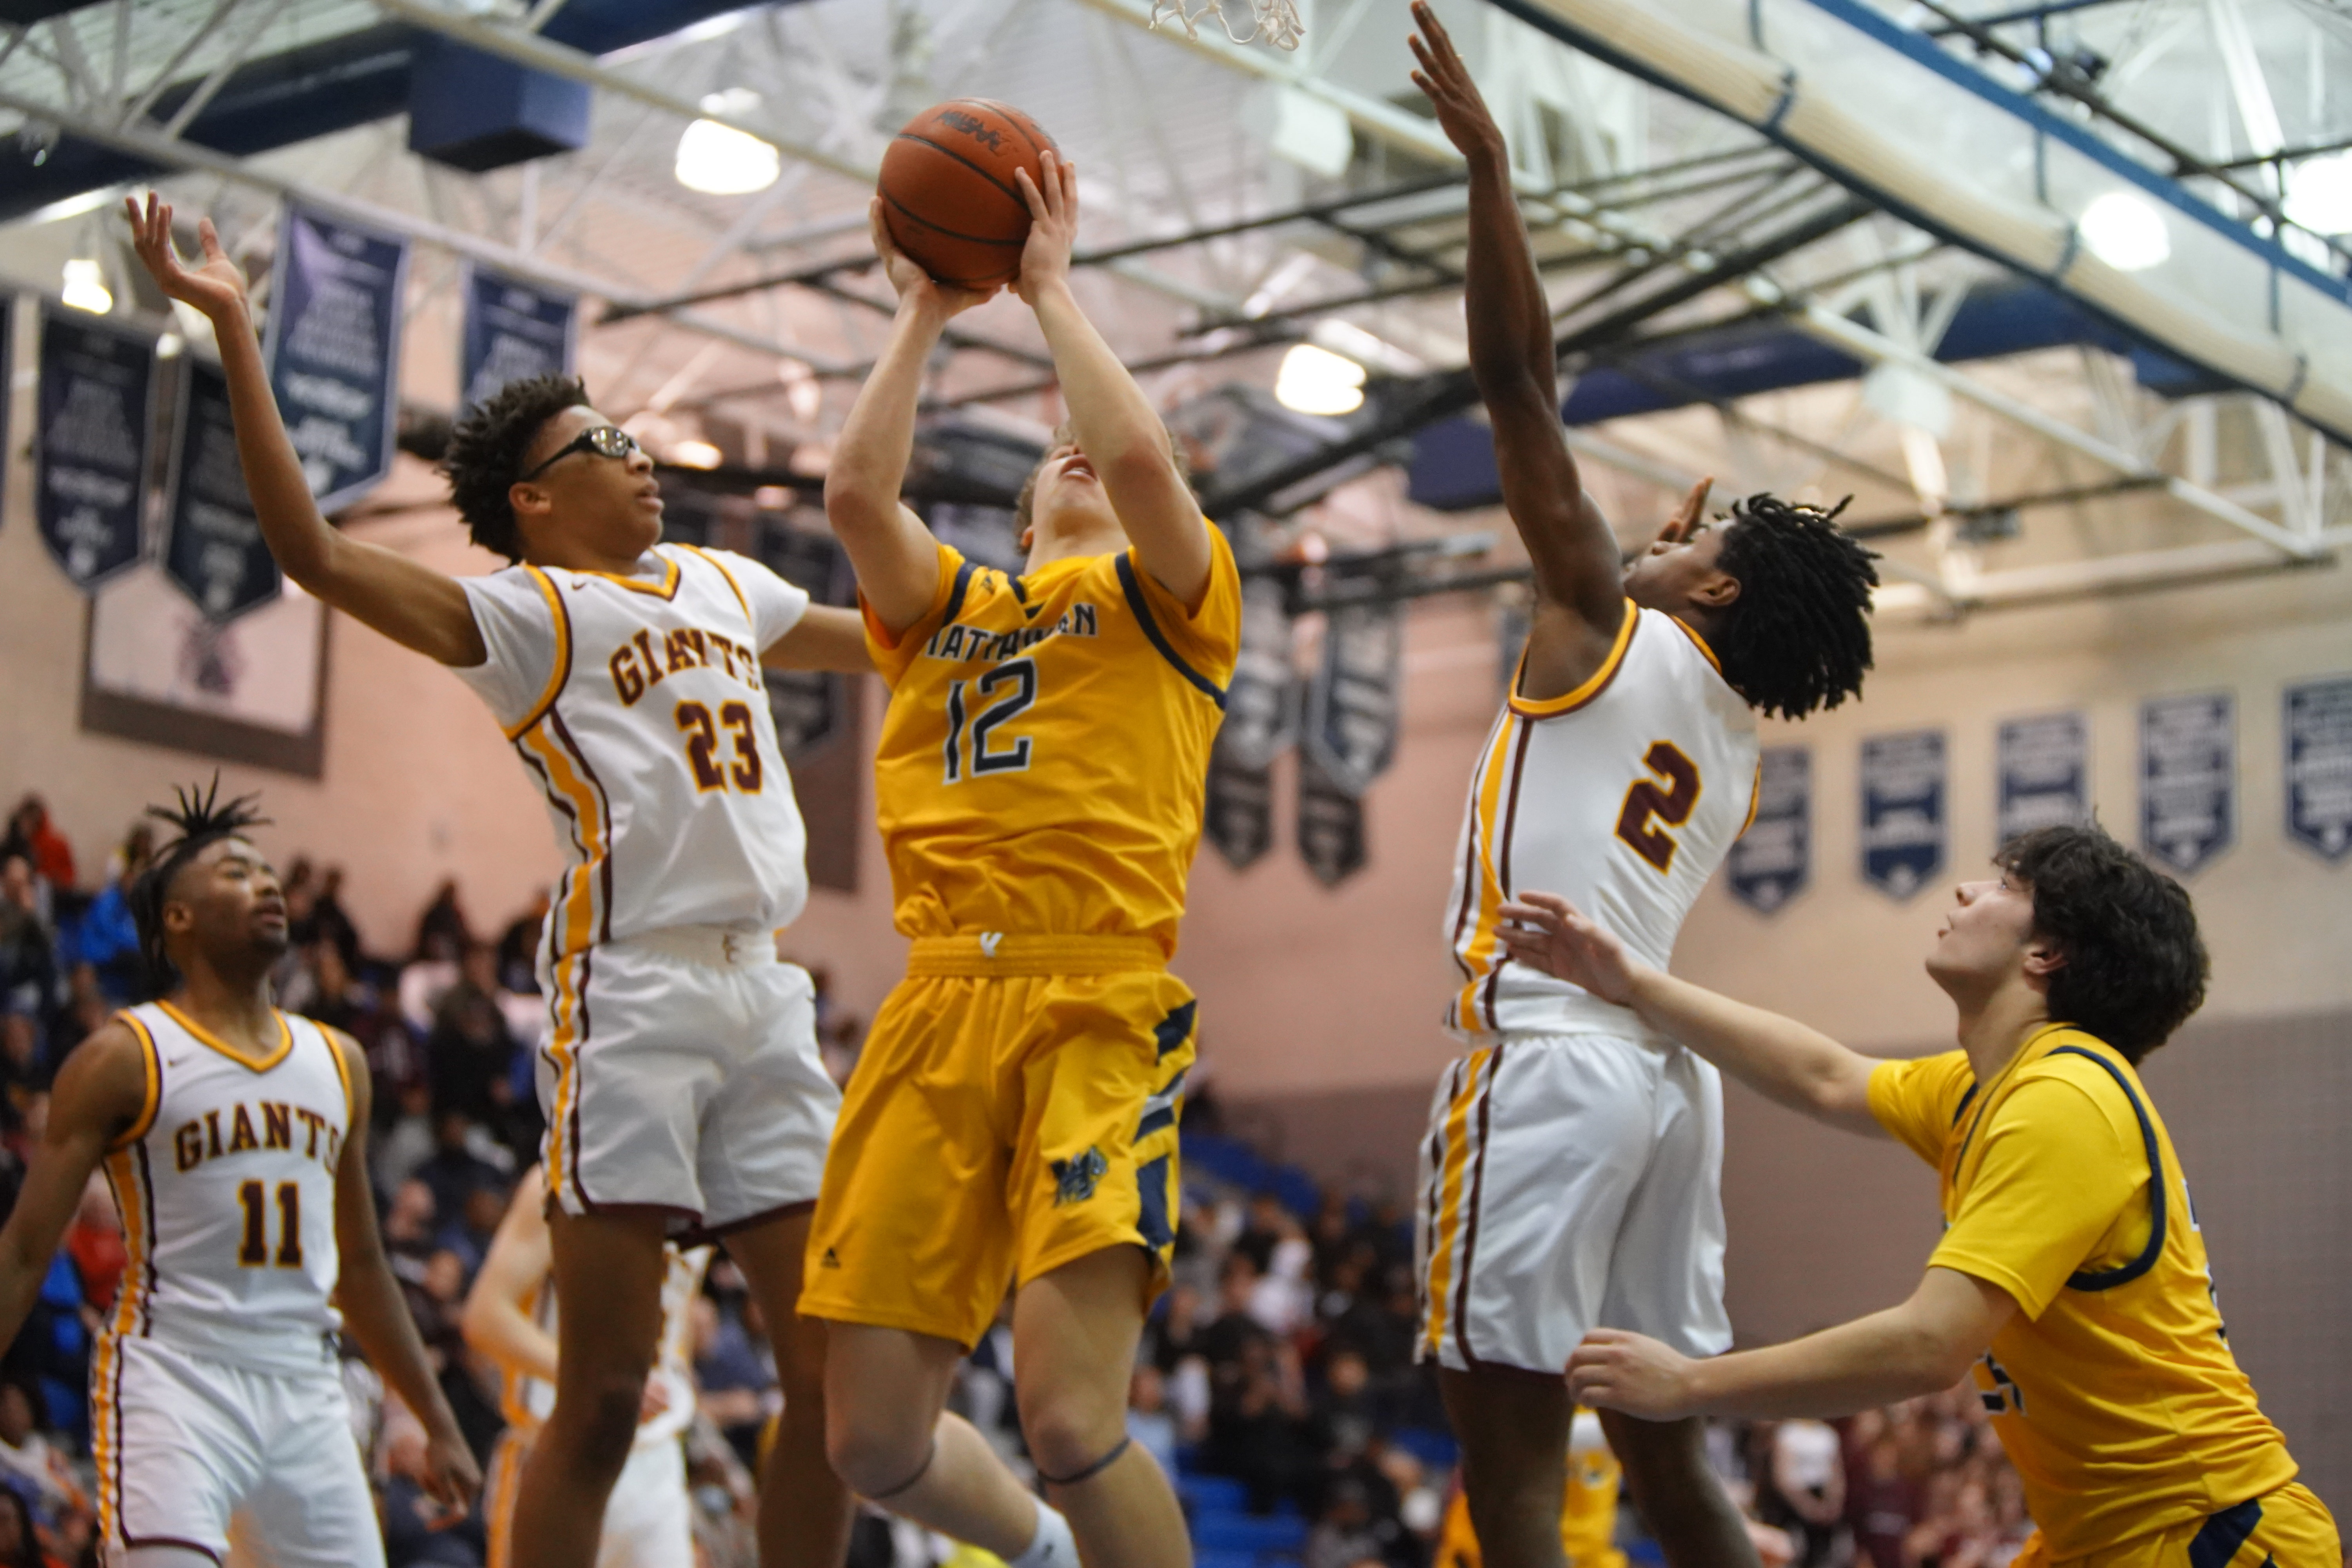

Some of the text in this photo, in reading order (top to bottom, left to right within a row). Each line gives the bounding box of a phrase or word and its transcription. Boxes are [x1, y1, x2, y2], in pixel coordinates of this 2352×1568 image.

[609, 629, 763, 706] GIANTS
[673, 700, 763, 795] 23
[942, 656, 1038, 786] 12
[1614, 740, 1702, 876] 2
[174, 1100, 340, 1176] GIANTS
[238, 1179, 302, 1269] 11
